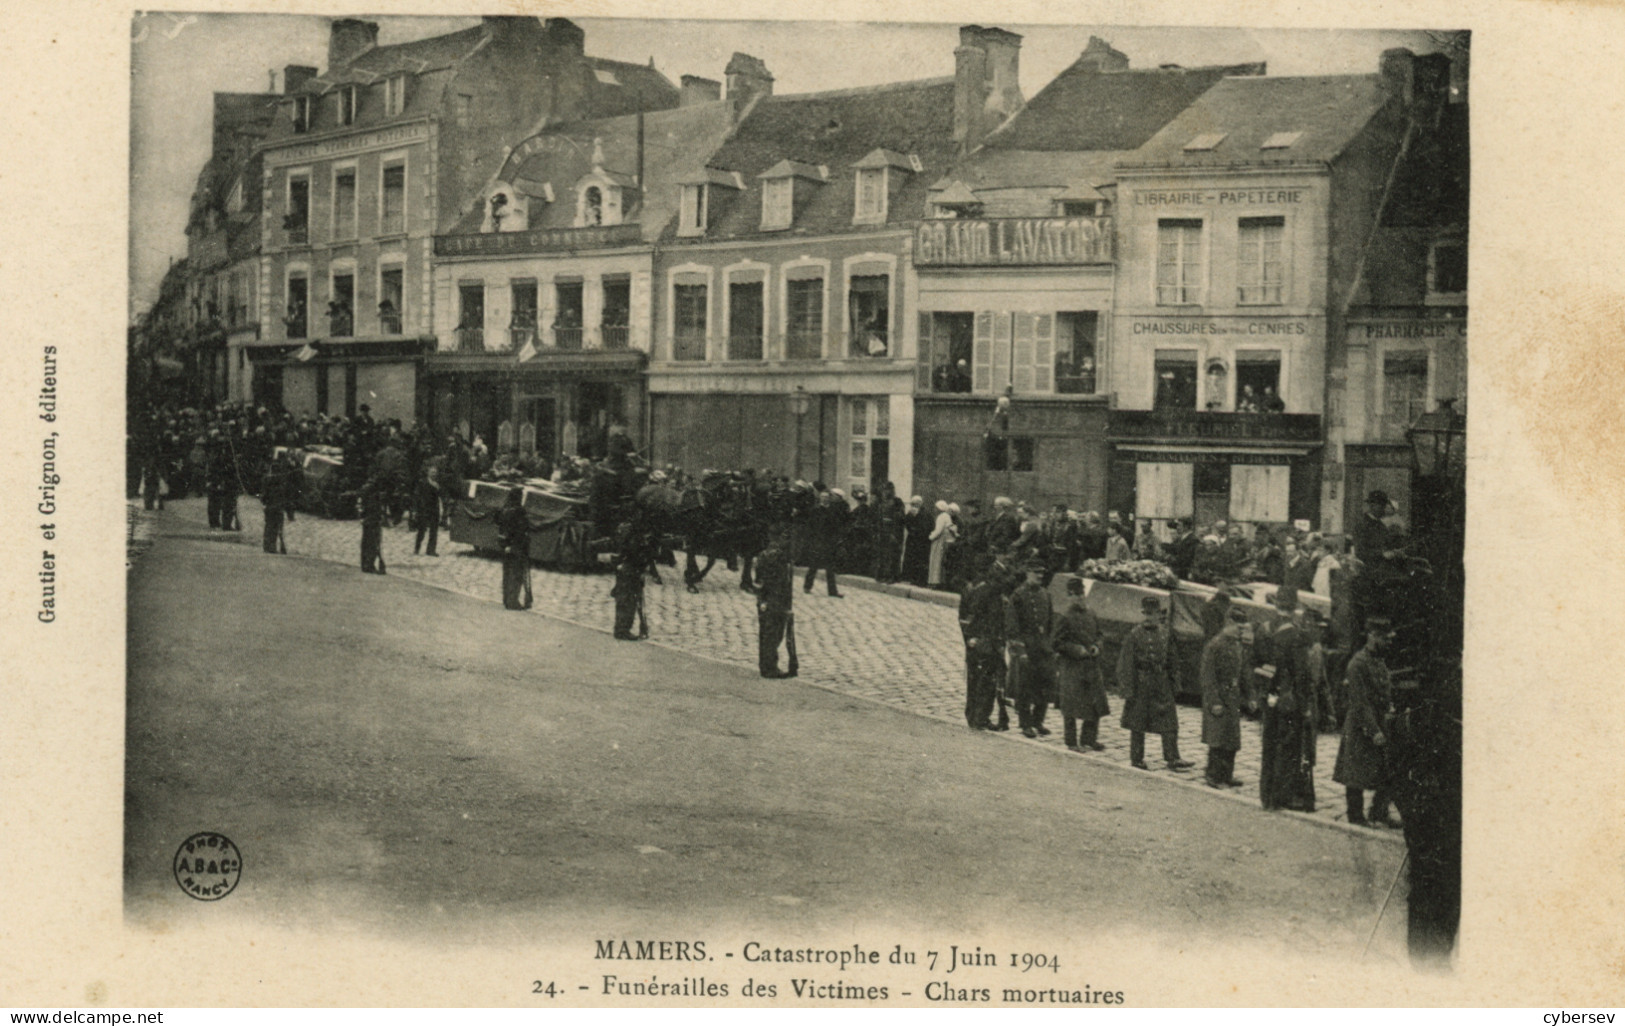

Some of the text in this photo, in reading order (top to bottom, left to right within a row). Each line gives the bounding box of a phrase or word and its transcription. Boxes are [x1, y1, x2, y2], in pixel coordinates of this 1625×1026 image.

[1134, 191, 1204, 206] LIBRAIRIE
[919, 219, 1111, 262] GRAND LAVATORY
[1133, 322, 1217, 335] CHAUSSURES
[1366, 324, 1446, 338] PHARMACIE
